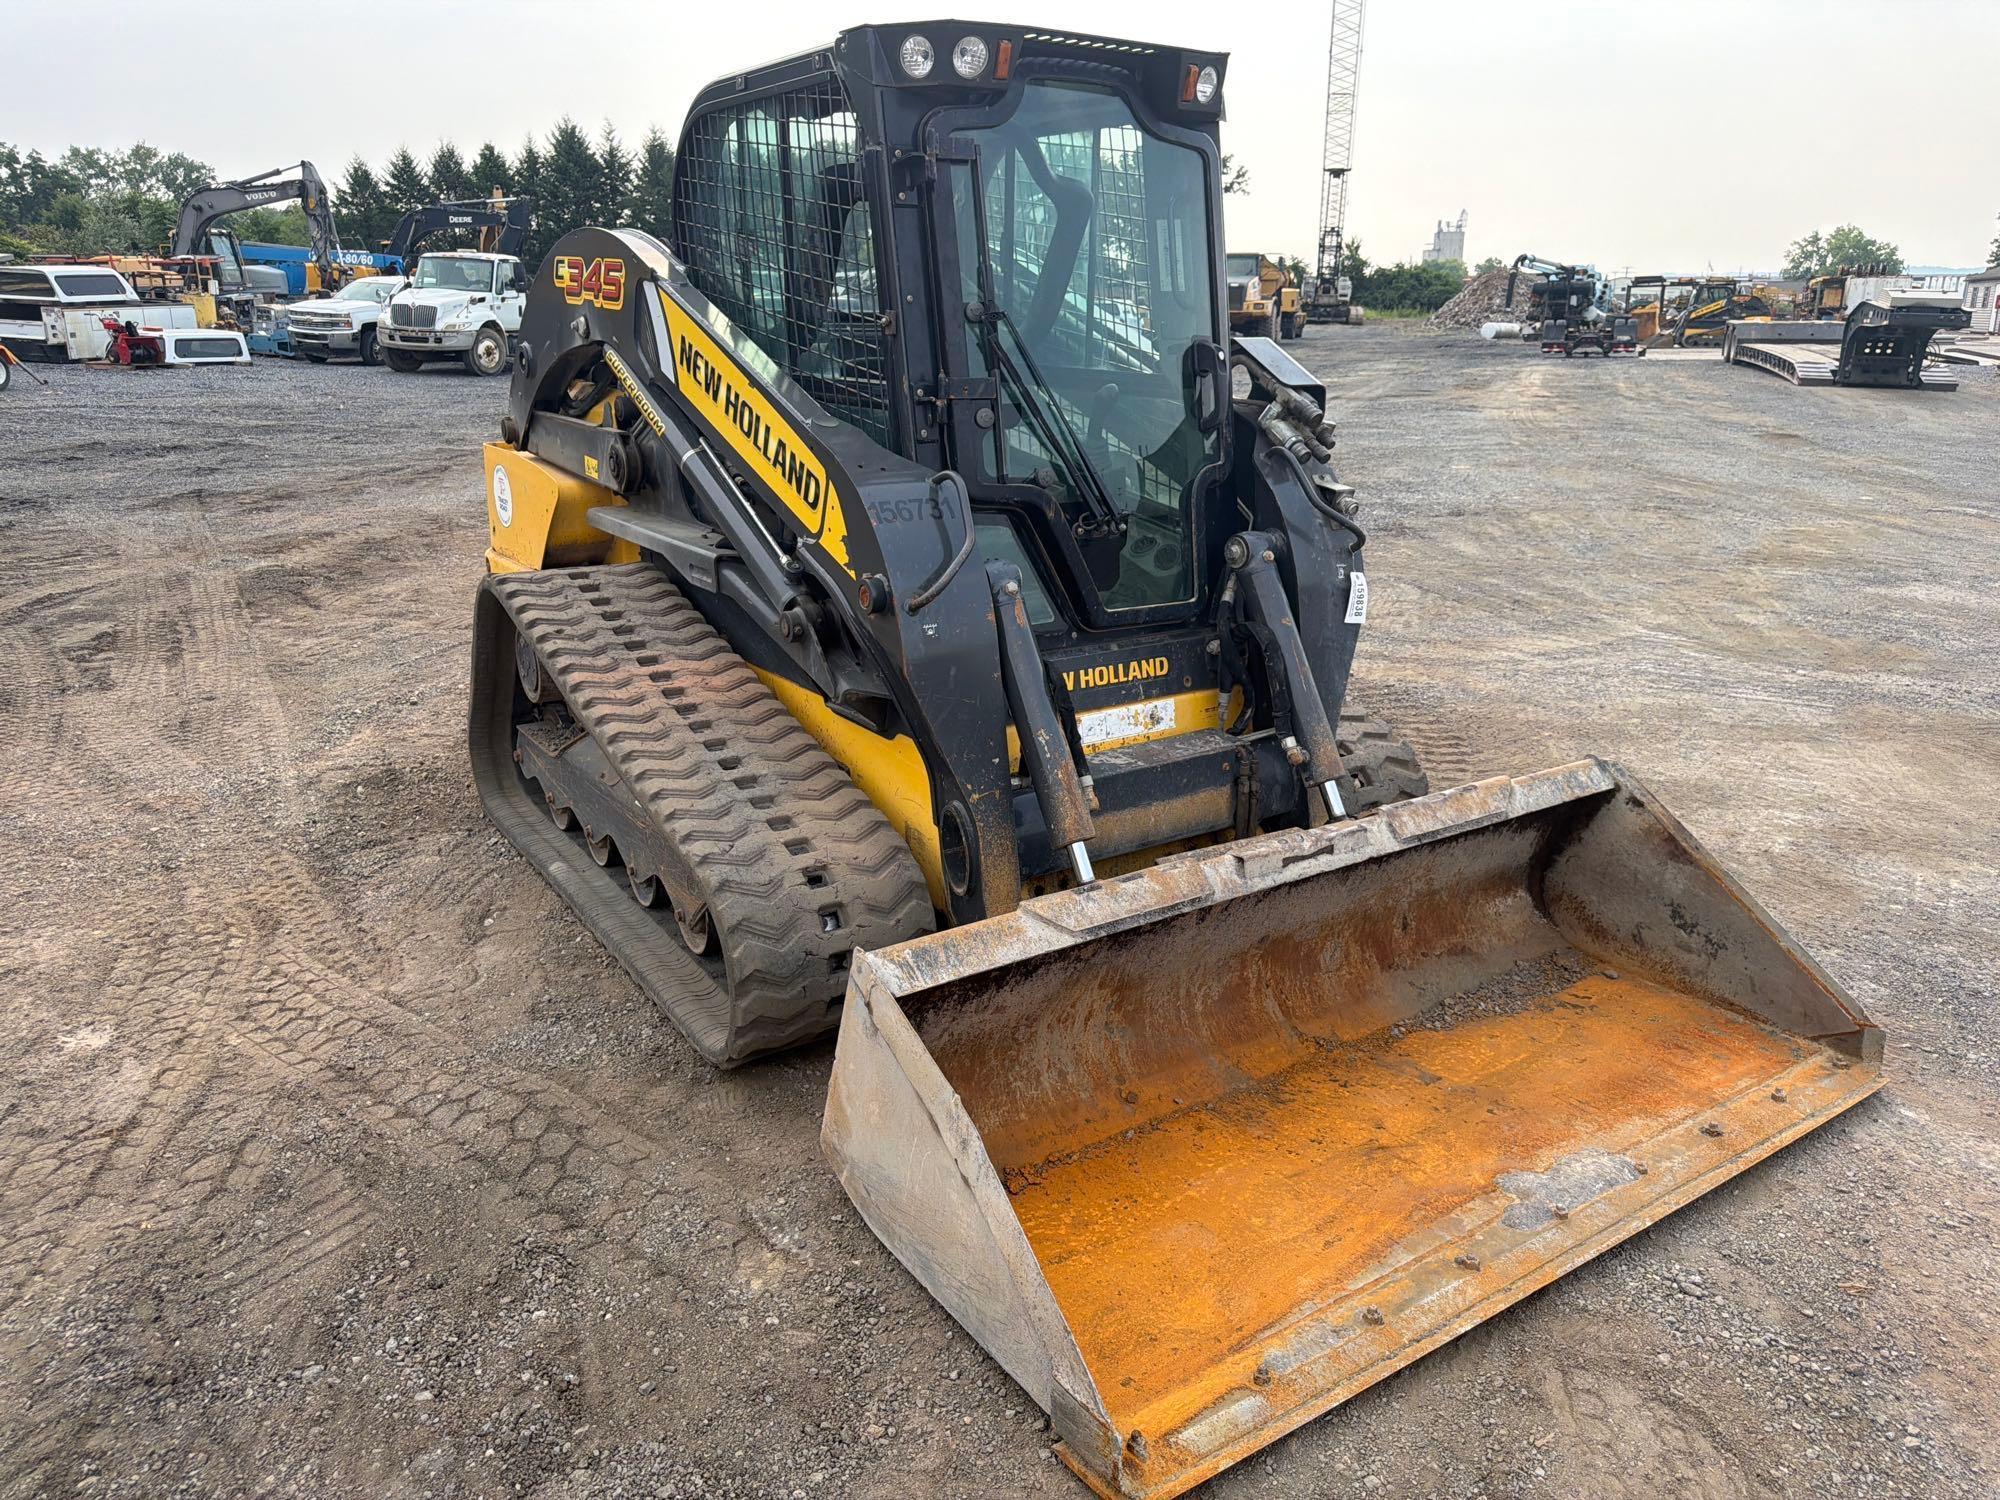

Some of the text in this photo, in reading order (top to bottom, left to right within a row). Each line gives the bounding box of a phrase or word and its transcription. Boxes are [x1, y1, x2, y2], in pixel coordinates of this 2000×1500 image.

[244, 191, 277, 201] VOLVO
[448, 215, 473, 223] DEERE
[679, 334, 821, 511] NEW HOLLAND
[867, 497, 956, 525] 156731
[1354, 583, 1365, 617] 159838
[1079, 656, 1169, 689] HOLLAND
